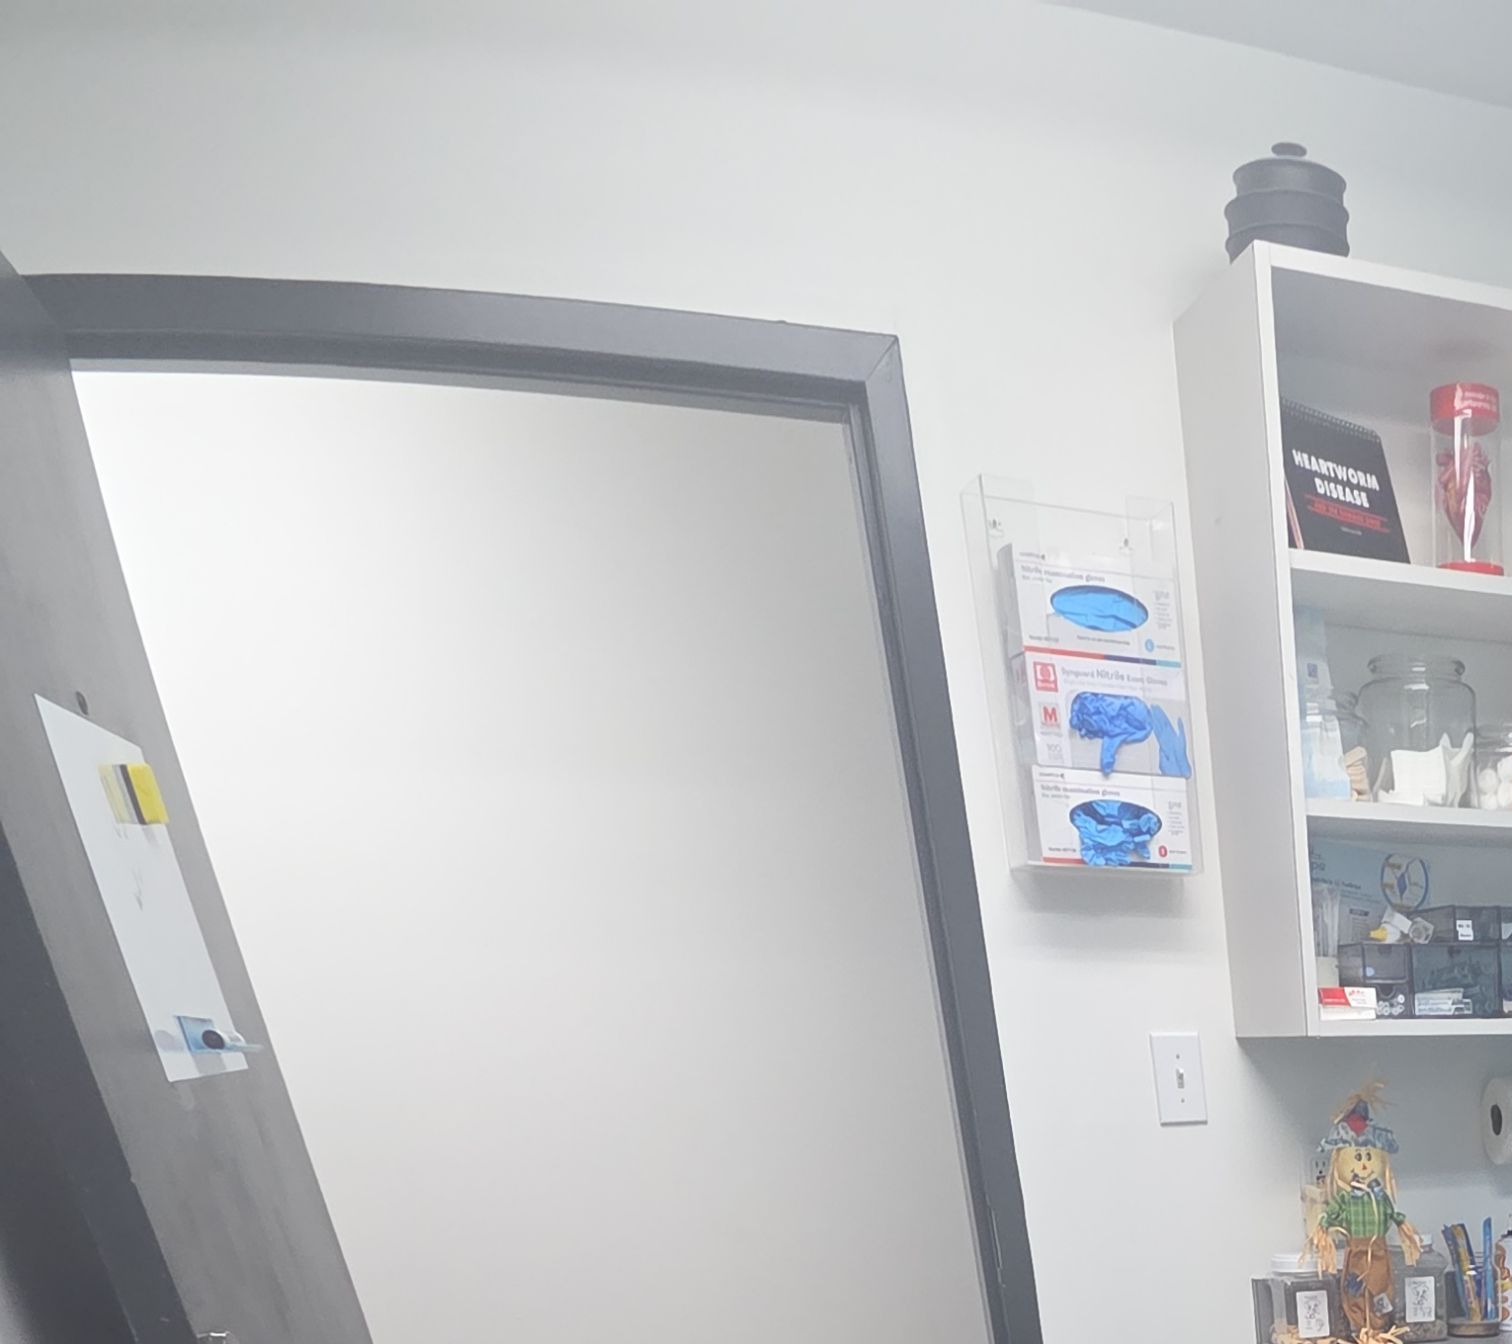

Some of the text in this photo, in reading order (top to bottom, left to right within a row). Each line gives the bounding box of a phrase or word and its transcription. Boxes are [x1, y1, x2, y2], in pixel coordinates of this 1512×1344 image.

[1292, 449, 1379, 491] HEARTWORM
[1314, 477, 1370, 508] DISEASE
[1043, 705, 1058, 721] M
